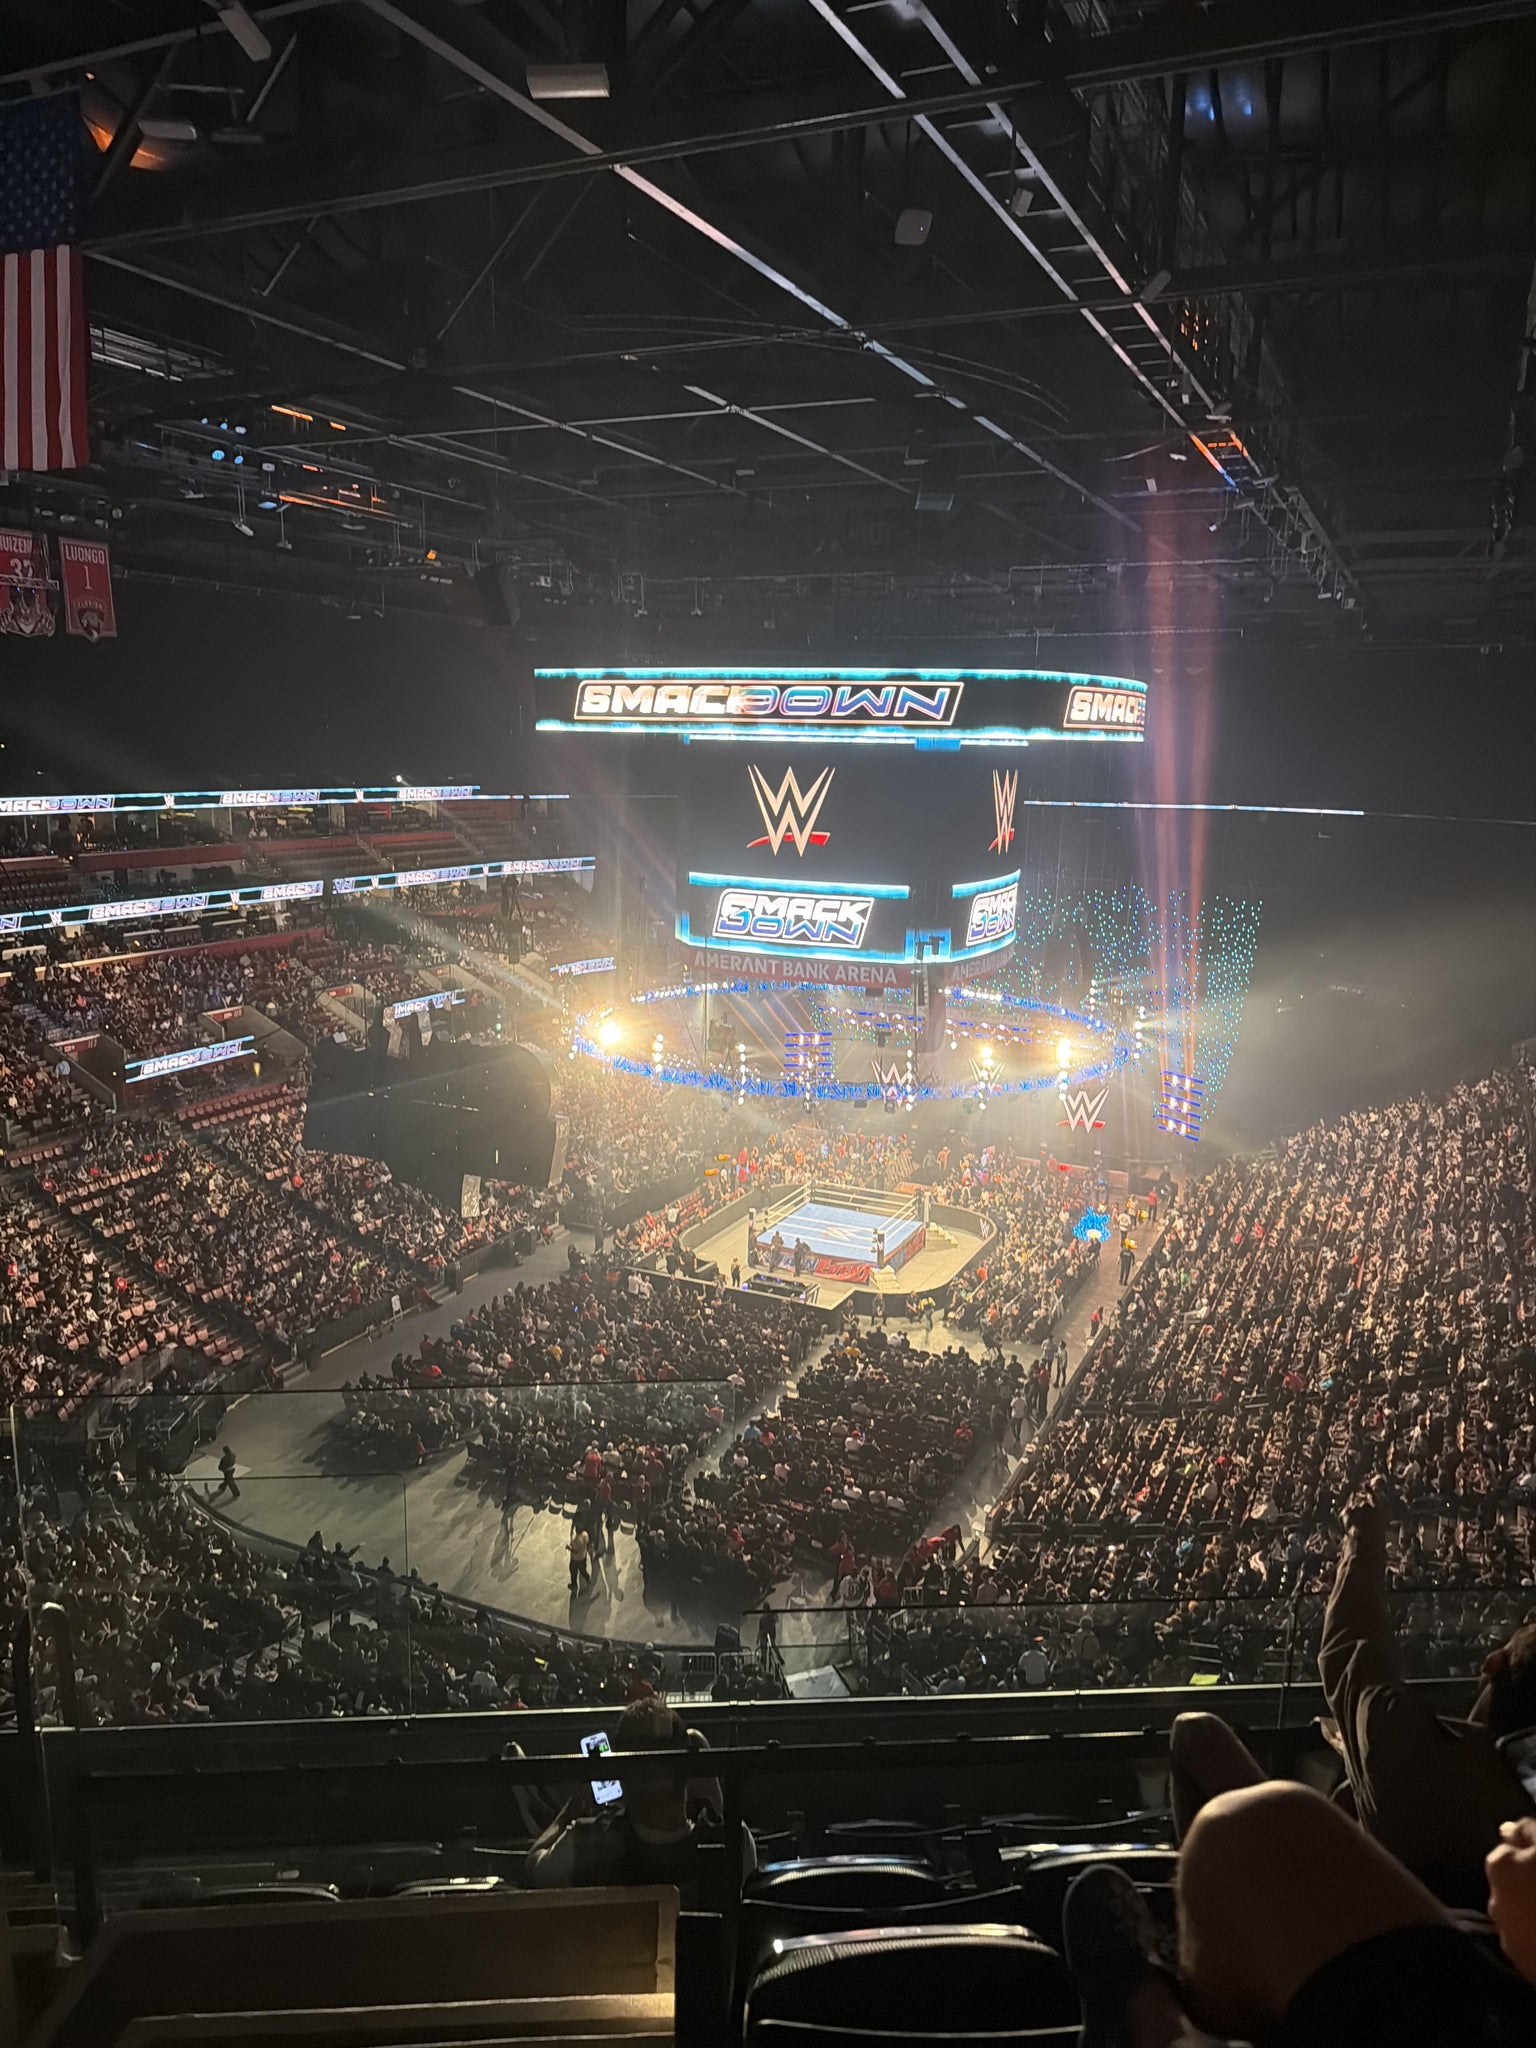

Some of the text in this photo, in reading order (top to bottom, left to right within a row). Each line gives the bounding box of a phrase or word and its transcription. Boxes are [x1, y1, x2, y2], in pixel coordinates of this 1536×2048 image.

[0, 535, 33, 554] UIZEN
[65, 545, 105, 564] LUONGO
[83, 565, 93, 590] 1
[0, 796, 113, 813] MACKDOWN
[721, 892, 871, 924] SMACK
[693, 953, 898, 985] AMERANT BANK ARENA
